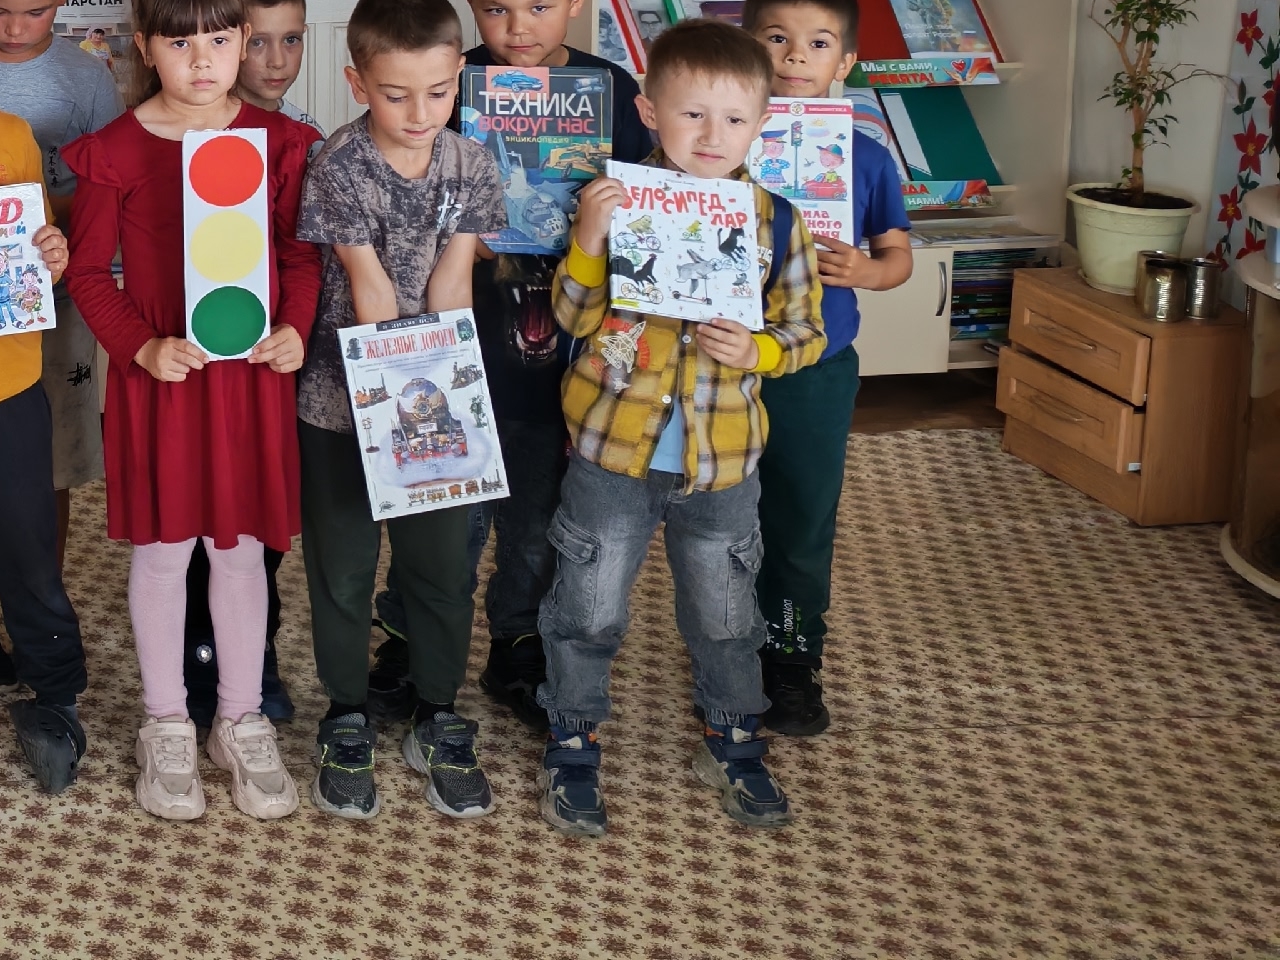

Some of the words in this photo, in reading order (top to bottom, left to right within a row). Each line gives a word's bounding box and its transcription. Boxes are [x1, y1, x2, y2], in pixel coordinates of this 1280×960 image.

[479, 91, 595, 117] ТЕХНИКА
[710, 212, 748, 227] ЛАР
[364, 334, 417, 359] ЖЕЛЕЗНЫЕ
[419, 328, 456, 351] ДОРОГИ
